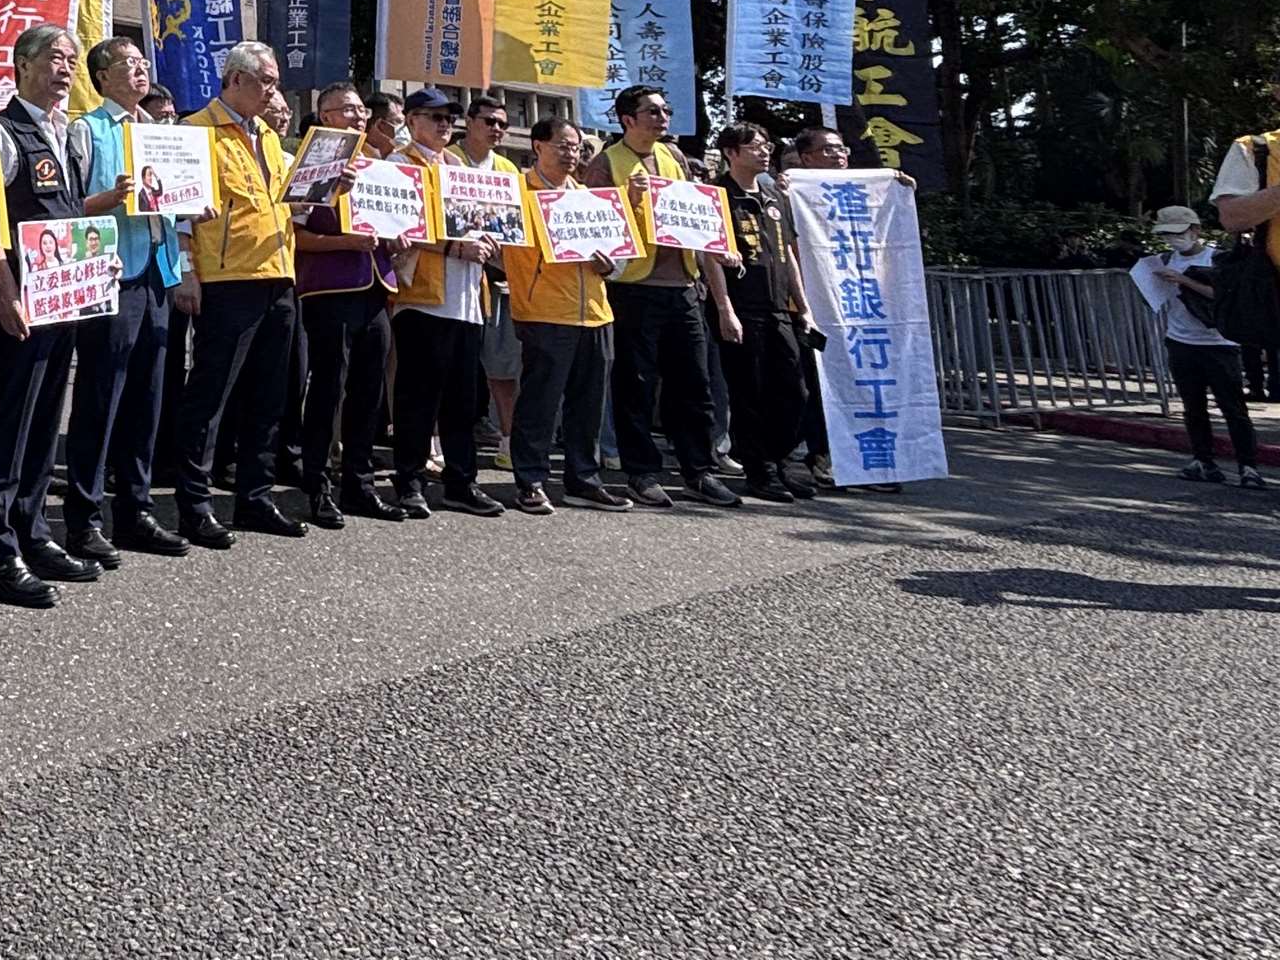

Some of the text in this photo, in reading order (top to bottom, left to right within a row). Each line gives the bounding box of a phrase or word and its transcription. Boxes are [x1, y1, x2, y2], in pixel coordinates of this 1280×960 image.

[32, 259, 109, 295] 立委無心修法
[33, 281, 110, 317] 藍綠欺騙勞工
[819, 181, 898, 470] 渣打銀行工會
